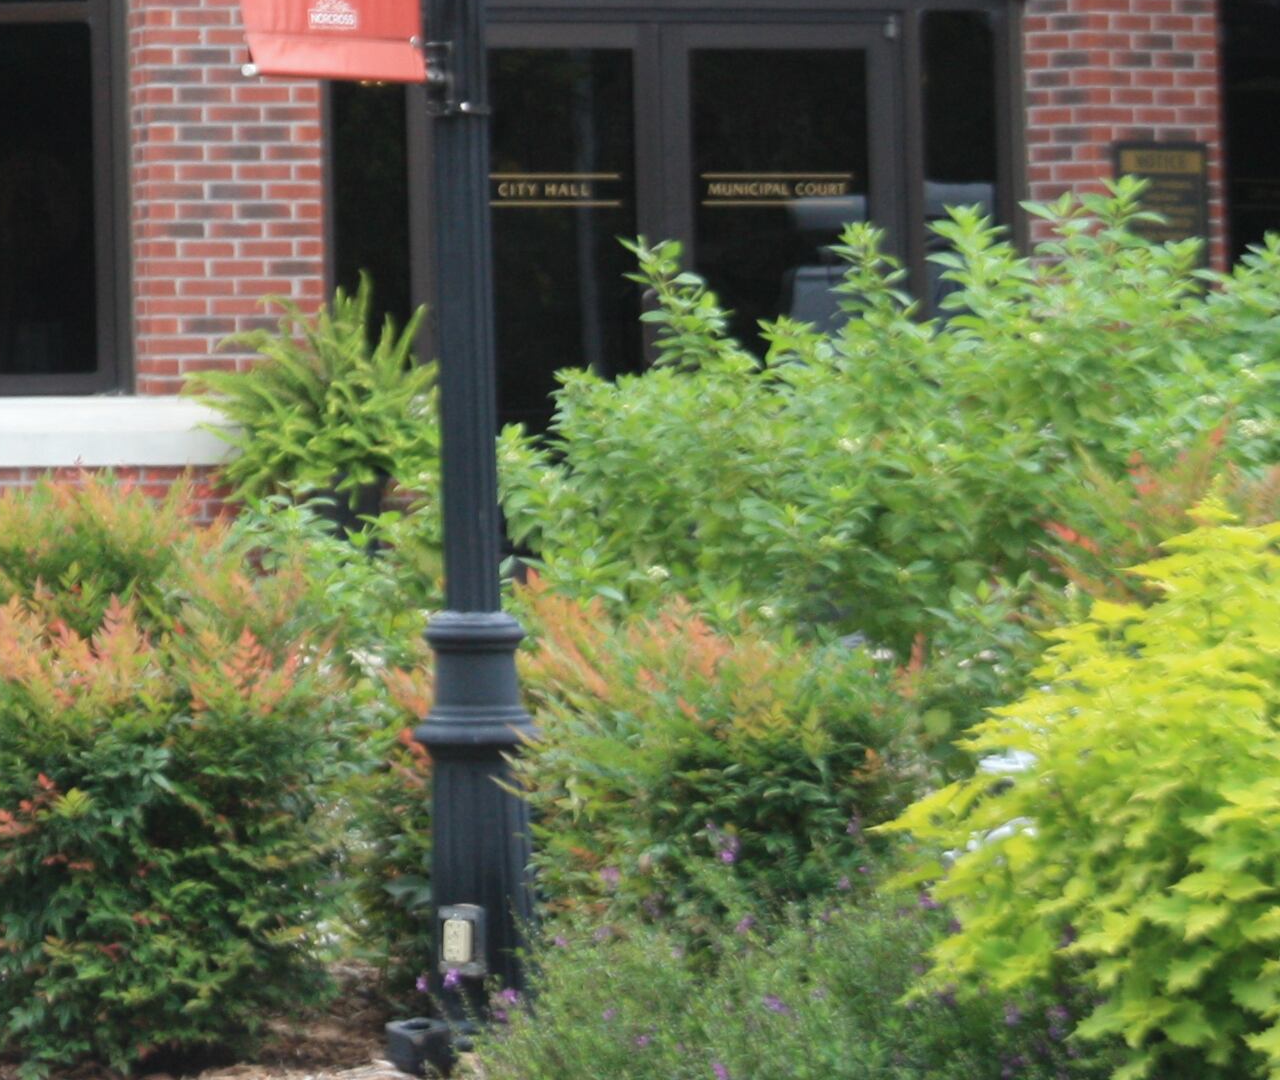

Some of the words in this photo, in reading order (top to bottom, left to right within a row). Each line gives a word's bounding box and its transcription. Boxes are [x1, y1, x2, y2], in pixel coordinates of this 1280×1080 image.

[310, 13, 354, 25] NORCROSS
[497, 183, 537, 197] CITY
[544, 183, 591, 197] HALL
[707, 182, 789, 196] MUNICIPAL
[794, 182, 847, 196] COURT
